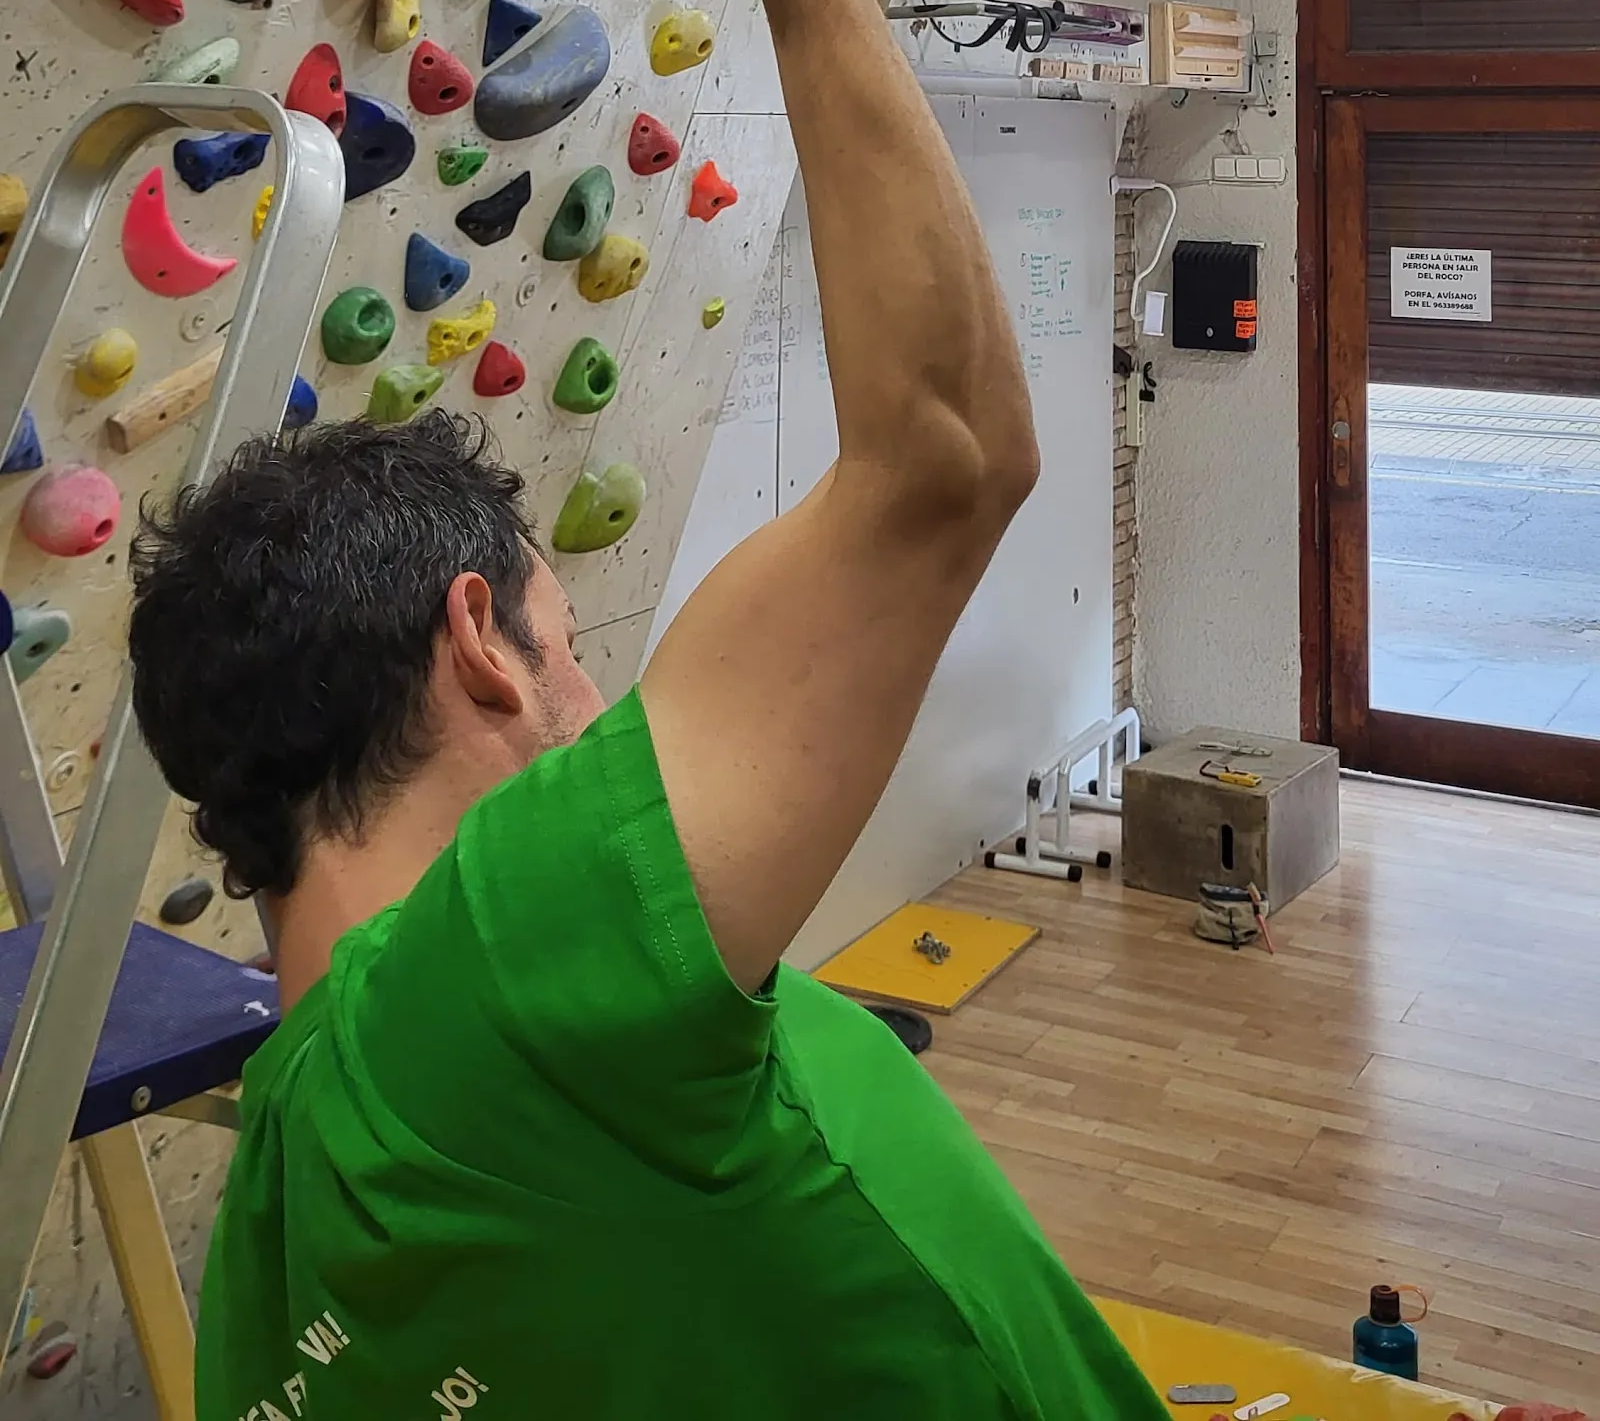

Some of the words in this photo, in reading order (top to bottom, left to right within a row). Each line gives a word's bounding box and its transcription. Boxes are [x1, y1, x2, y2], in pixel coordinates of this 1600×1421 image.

[1443, 253, 1474, 262] ÚLTIMA
[1456, 264, 1478, 272] SALIR
[1417, 272, 1433, 280] DEL
[1404, 290, 1435, 299] PORFA,
[1437, 291, 1477, 300] AVÍSANOS
[296, 1310, 350, 1365] VA!
